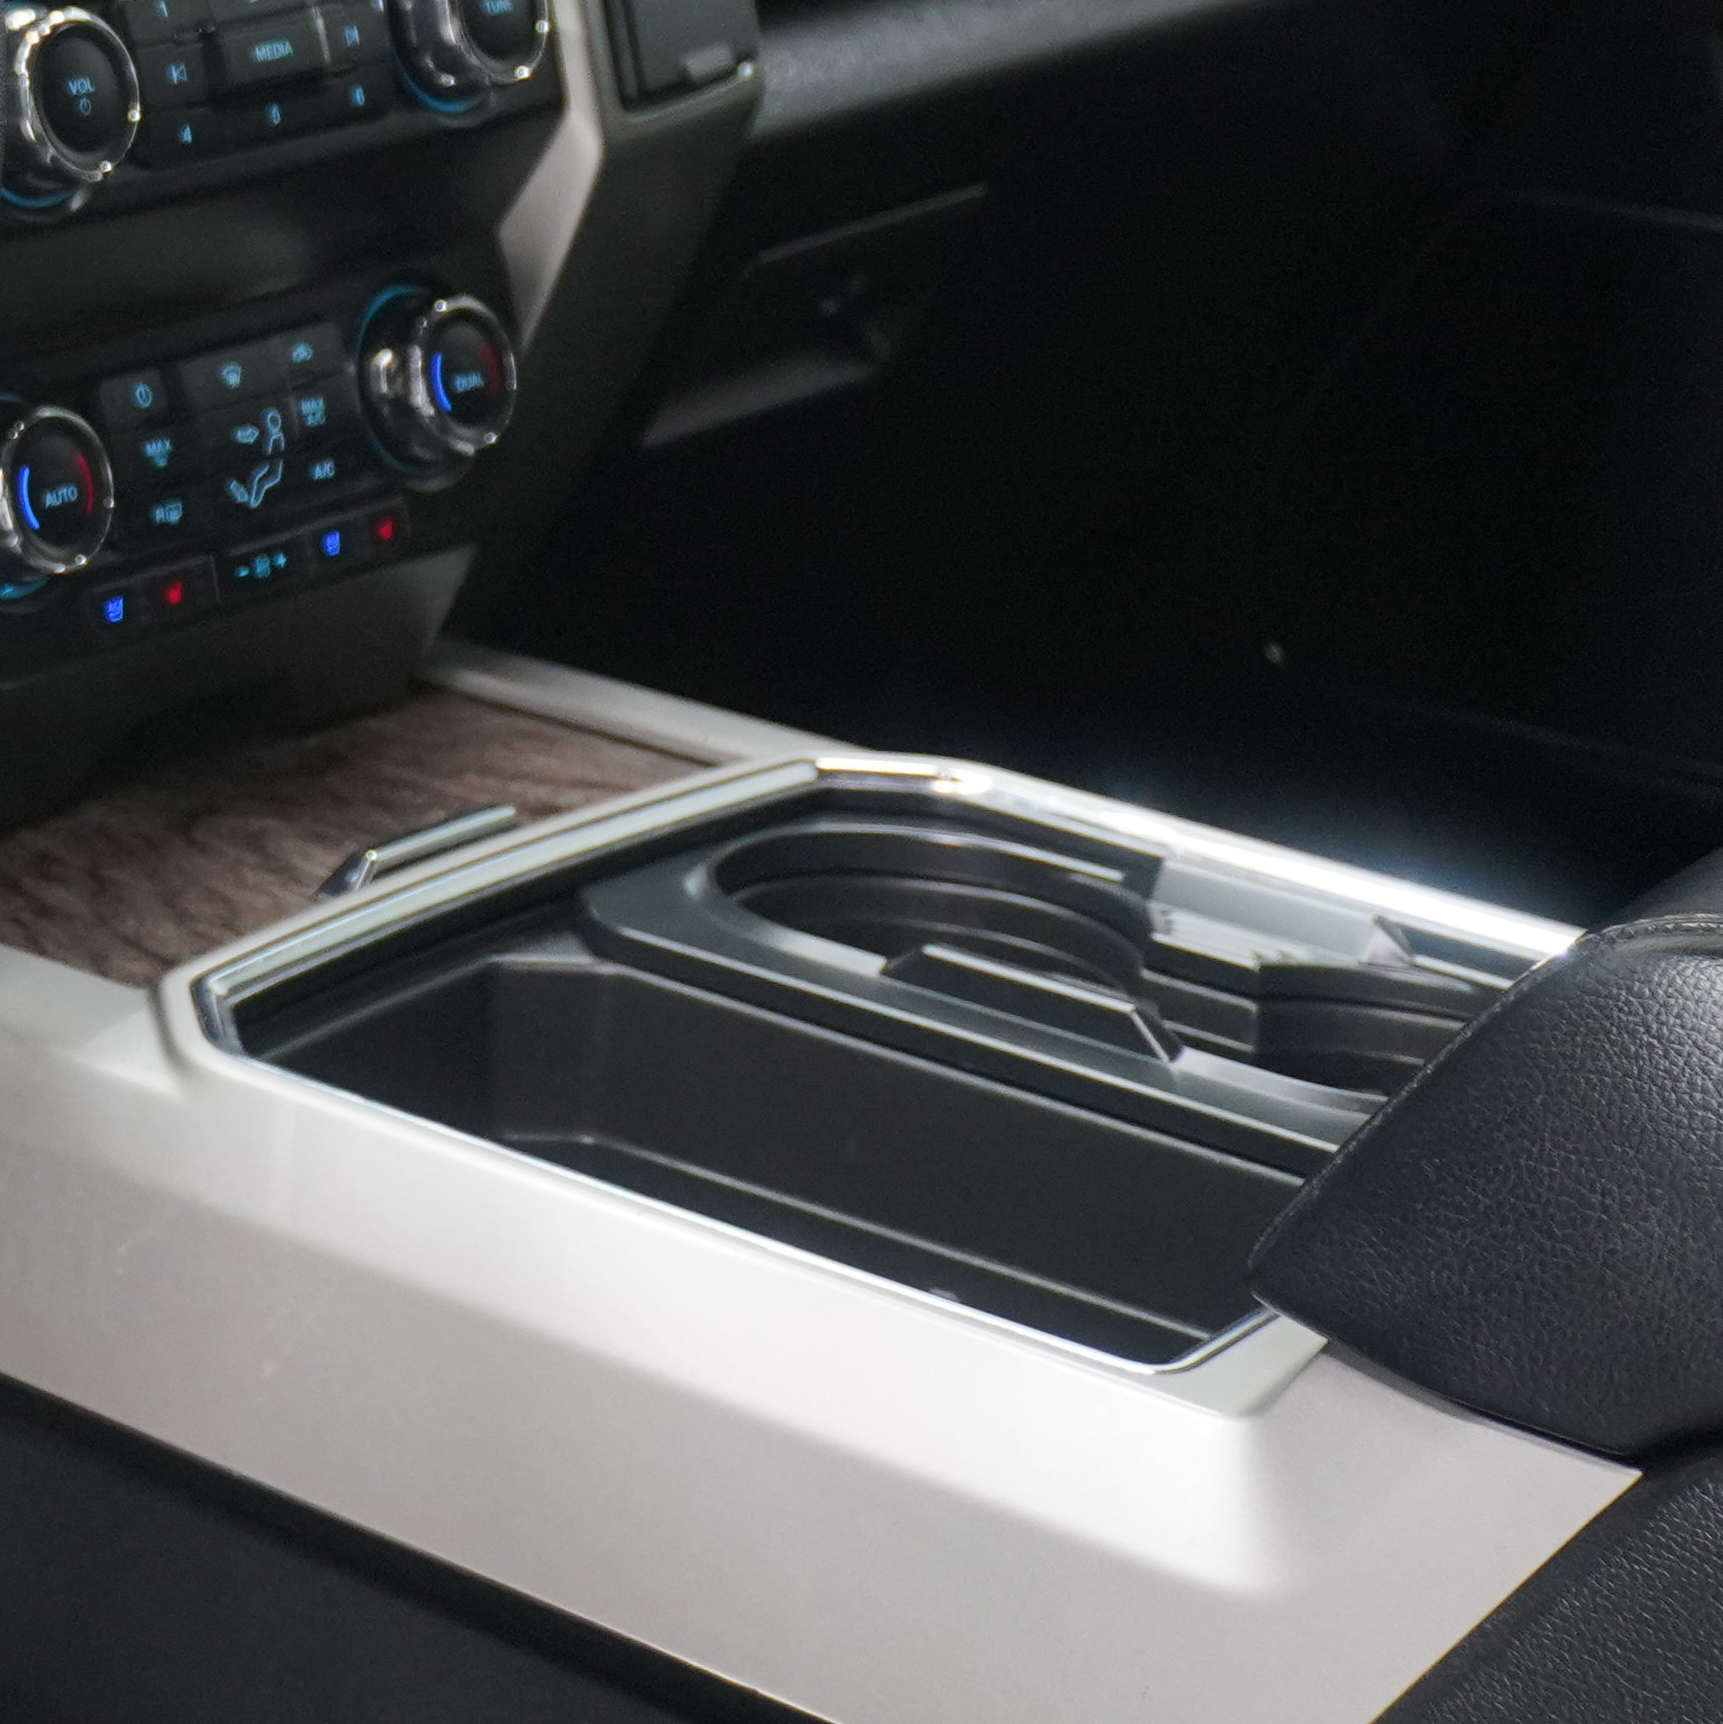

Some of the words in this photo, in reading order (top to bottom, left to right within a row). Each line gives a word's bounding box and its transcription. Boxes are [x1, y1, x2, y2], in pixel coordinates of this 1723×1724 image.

[255, 39, 293, 62] MEDIA
[69, 77, 96, 95] VOL
[455, 372, 483, 392] DUAL
[313, 459, 335, 480] A/C
[44, 486, 78, 507] AUTO
